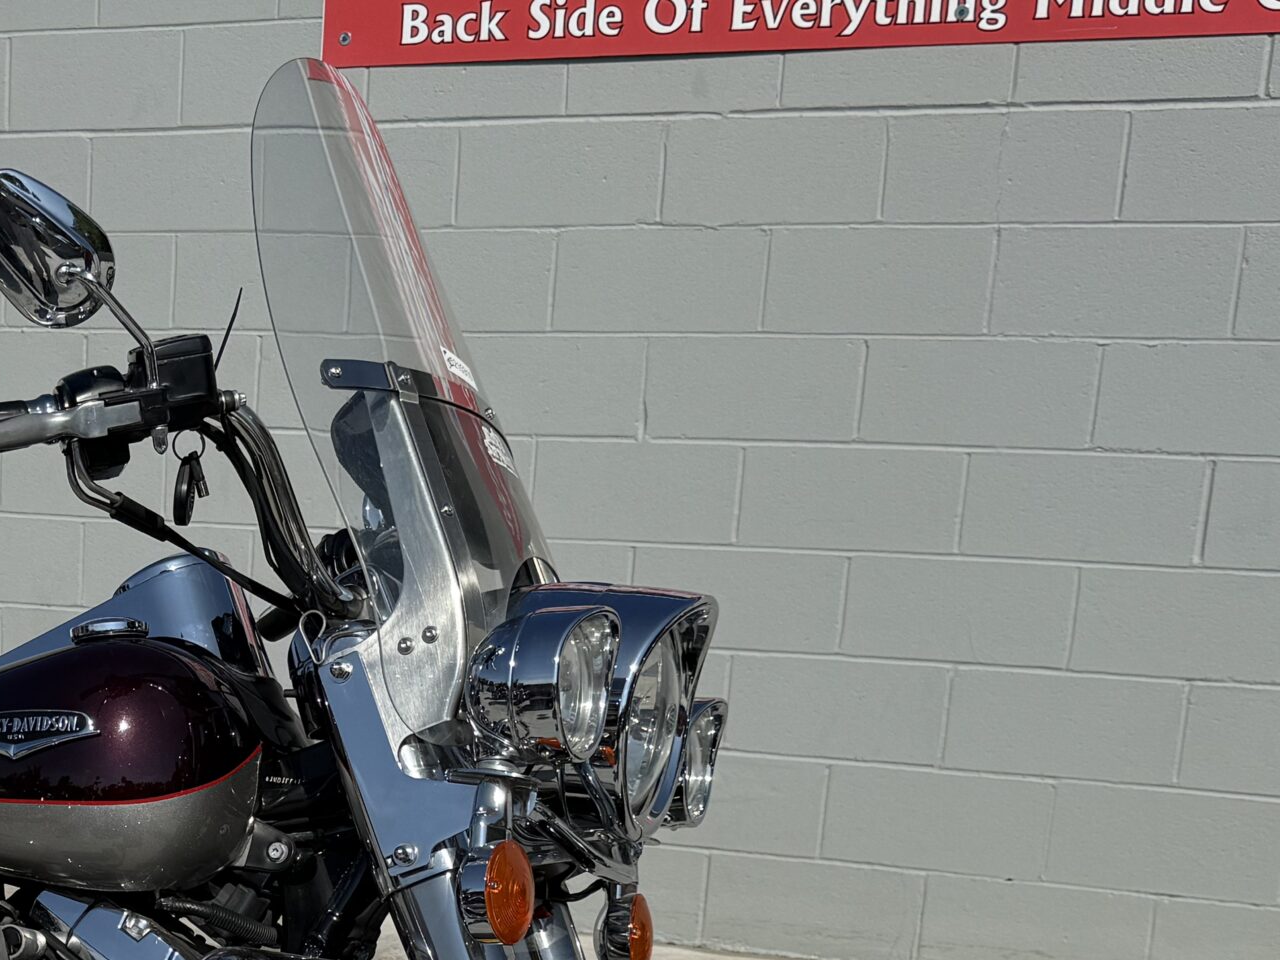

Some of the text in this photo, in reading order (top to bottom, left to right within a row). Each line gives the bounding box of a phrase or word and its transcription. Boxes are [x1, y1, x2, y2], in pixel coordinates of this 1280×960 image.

[400, 0, 509, 45] Back
[527, 0, 623, 40] Side
[643, 0, 707, 34] Of
[729, 0, 1007, 37] Everything
